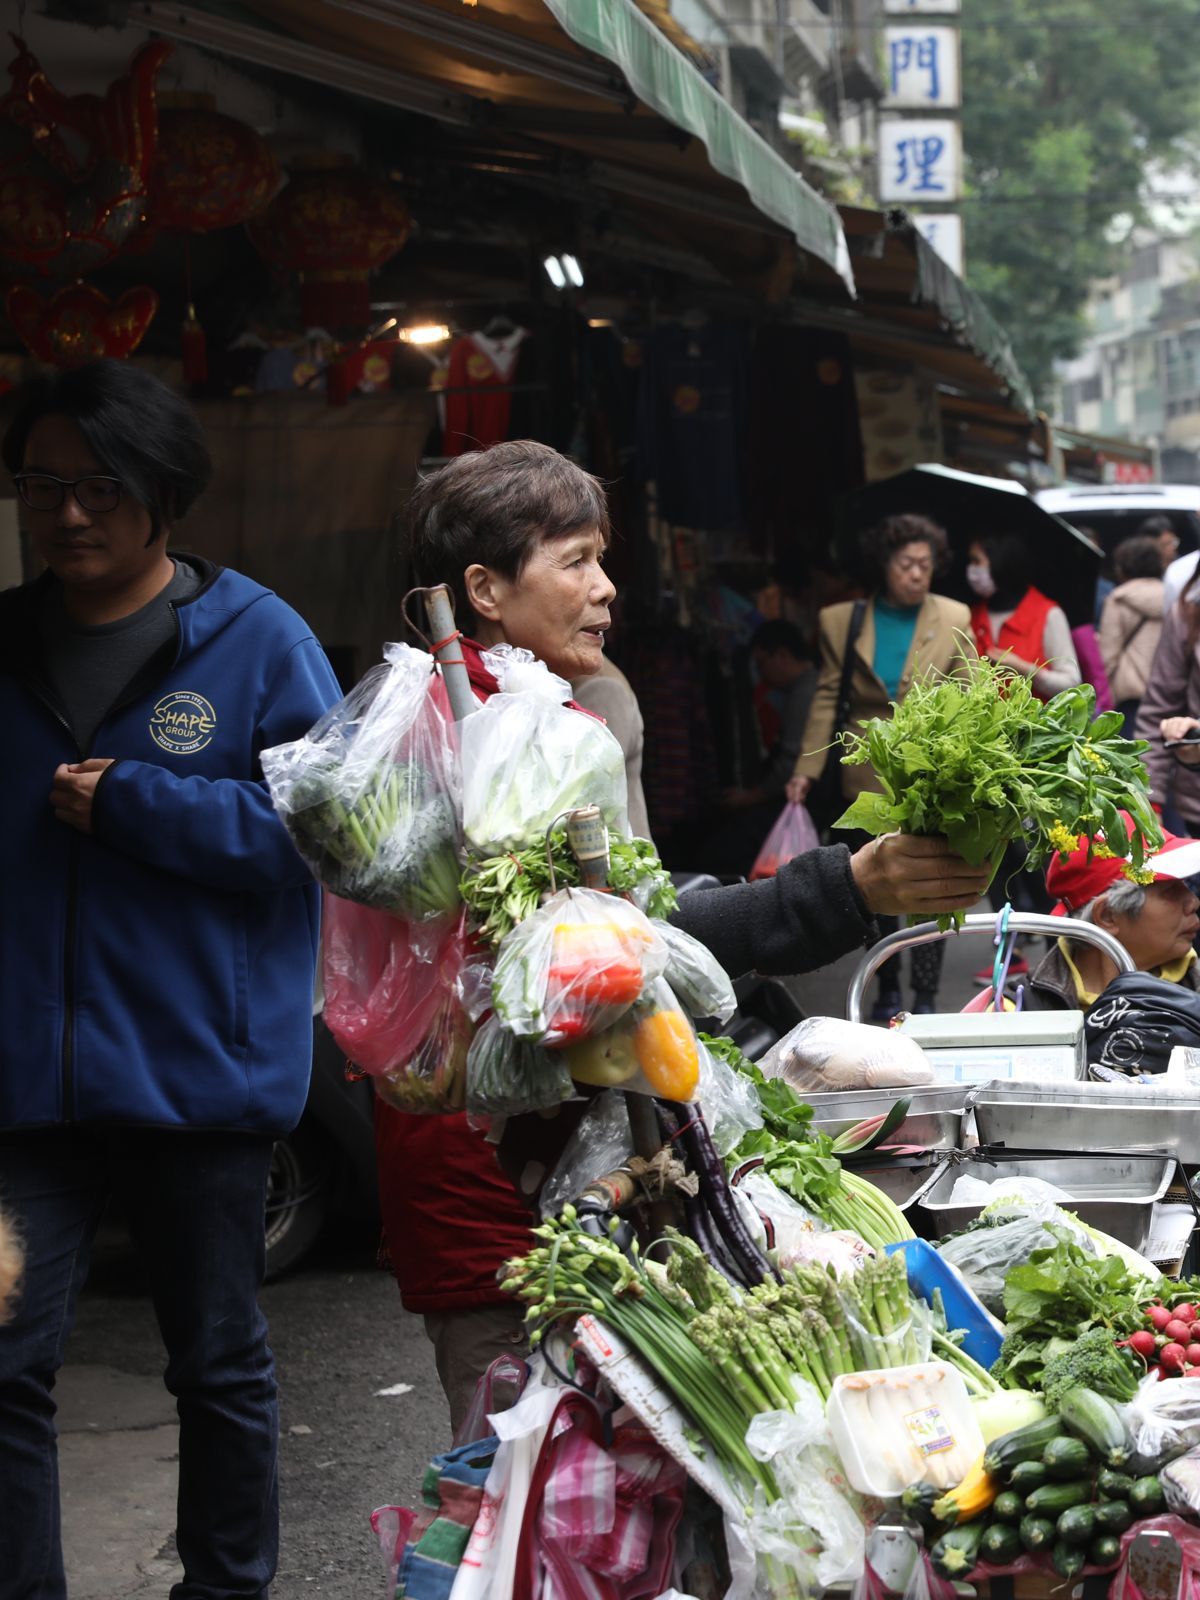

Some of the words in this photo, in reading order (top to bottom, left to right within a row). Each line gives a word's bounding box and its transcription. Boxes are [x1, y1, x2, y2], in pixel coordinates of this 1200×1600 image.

[151, 708, 215, 733] SHAPE
[165, 726, 196, 738] GROUP
[157, 736, 173, 749] SHAPE
[181, 742, 200, 751] SHARE
